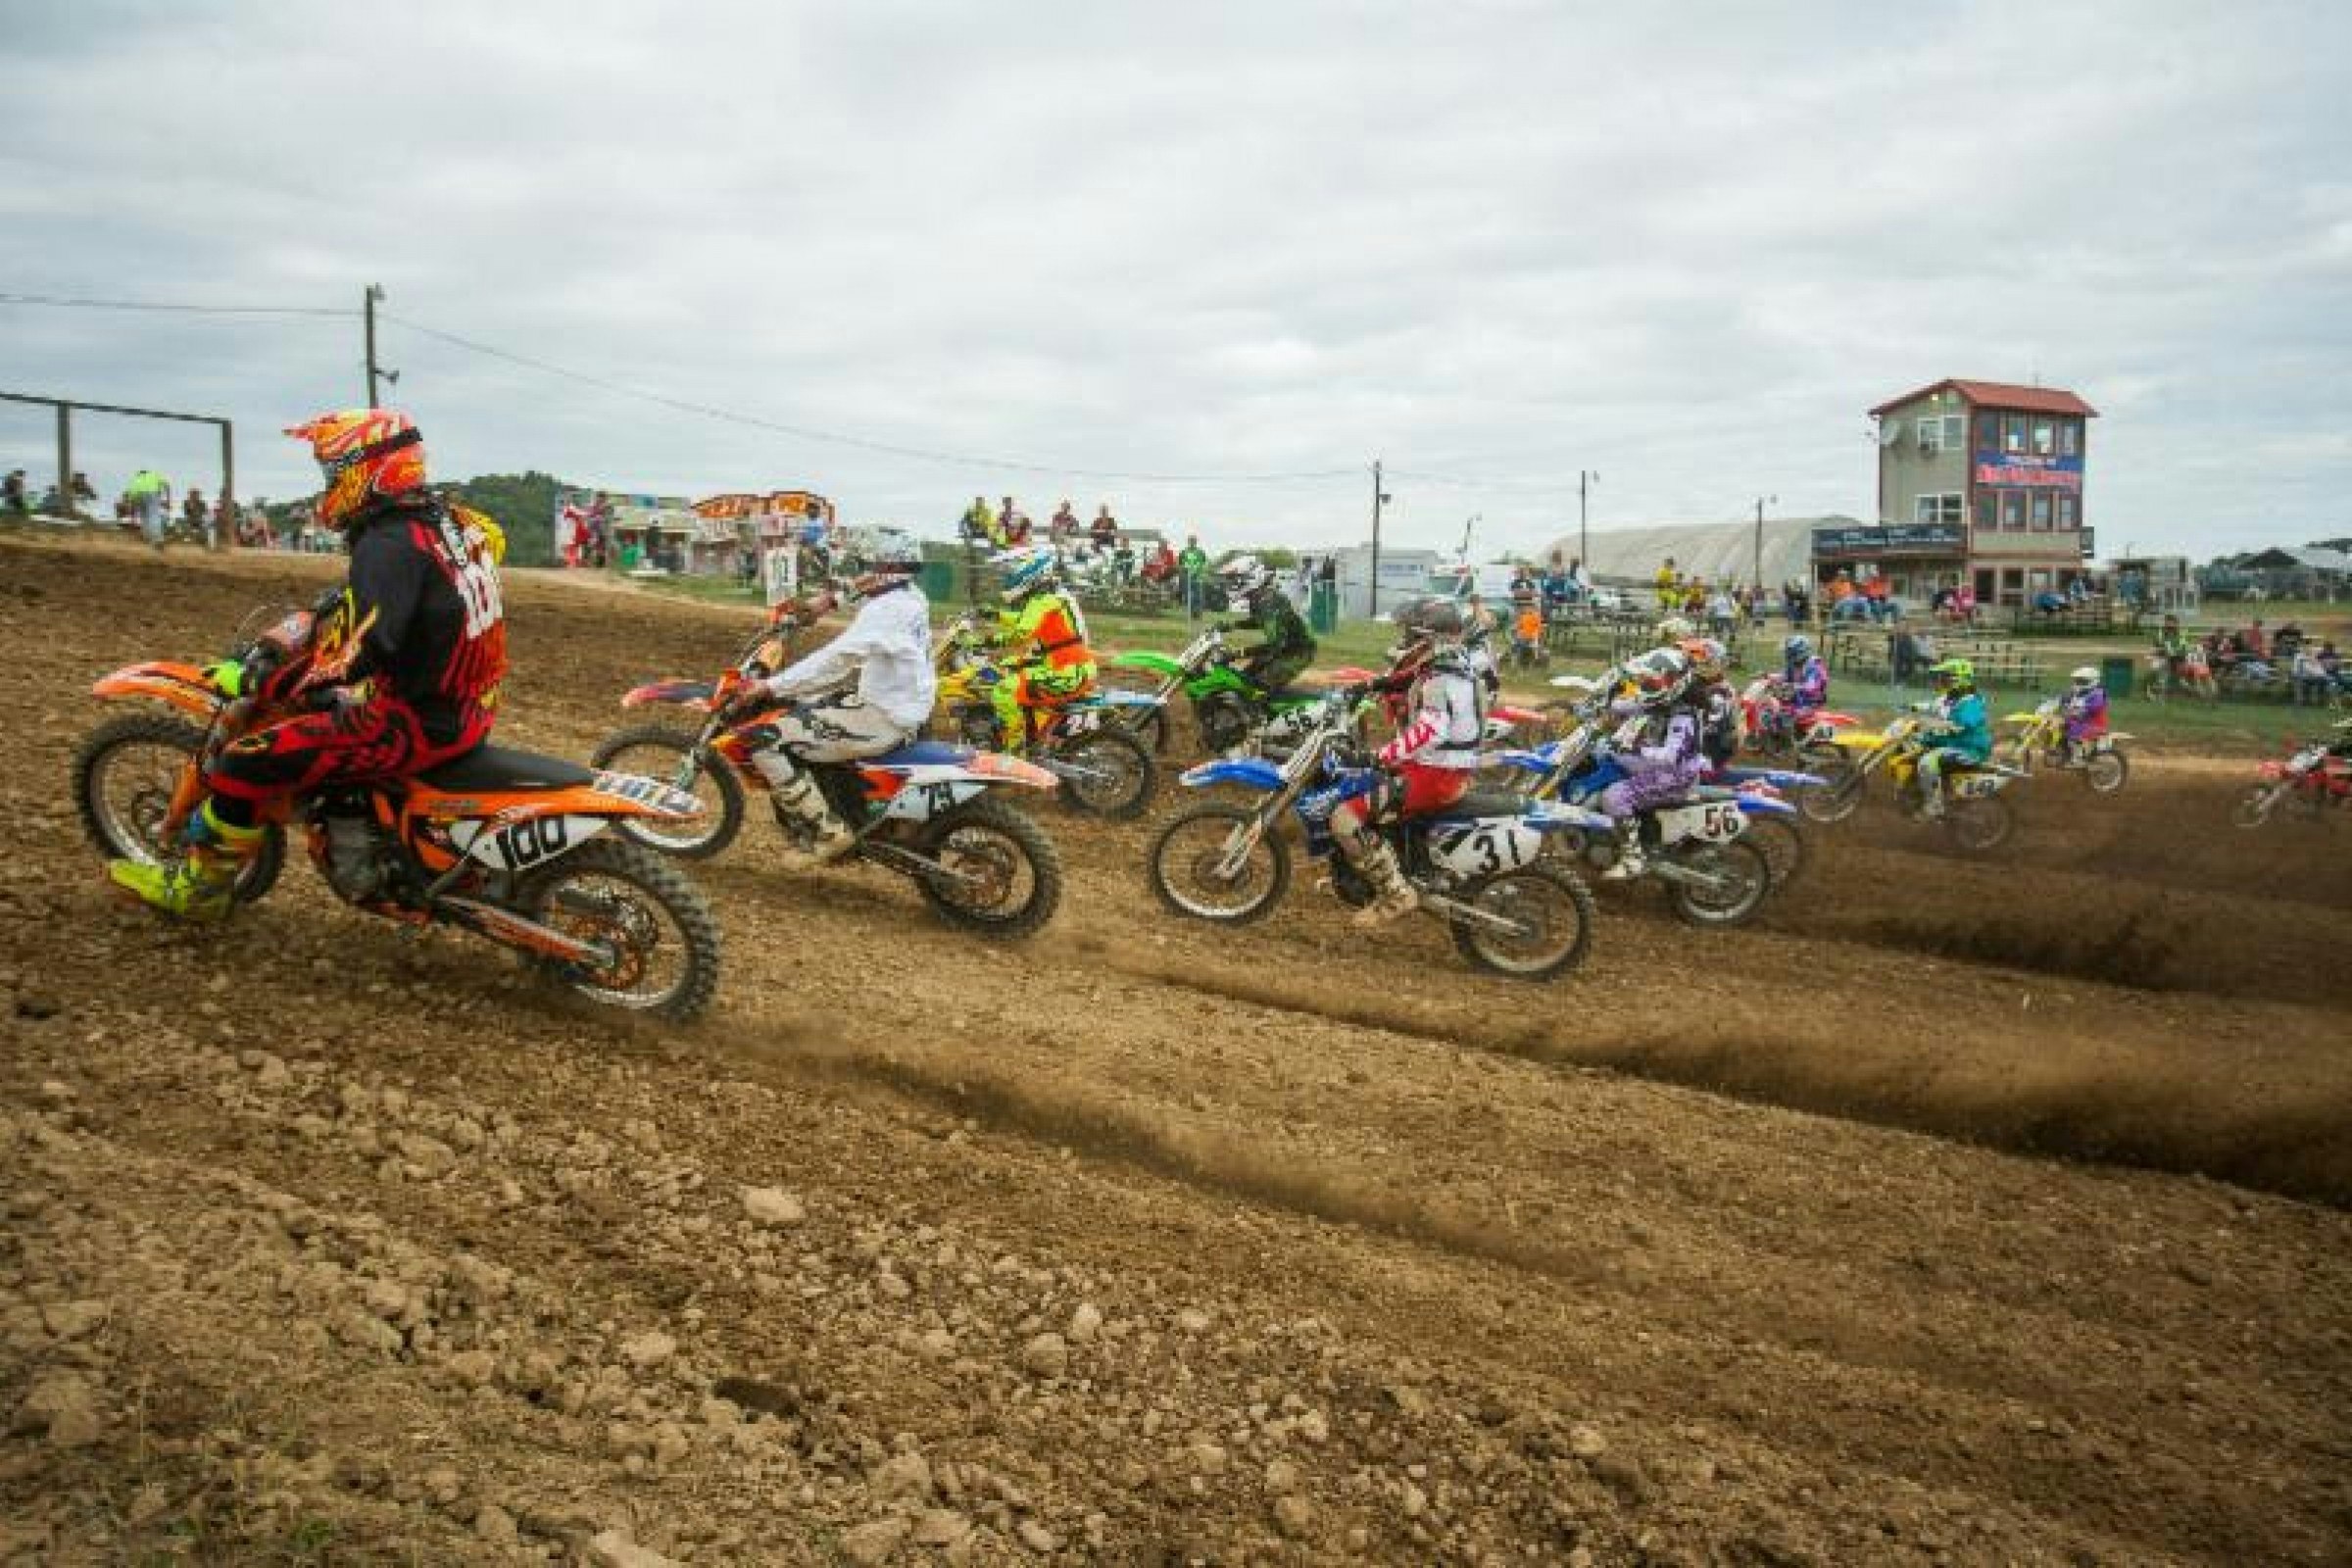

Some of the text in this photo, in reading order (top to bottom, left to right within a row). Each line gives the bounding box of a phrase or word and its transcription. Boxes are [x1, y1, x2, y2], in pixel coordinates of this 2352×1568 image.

[495, 814, 567, 872] 100
[1705, 806, 1739, 839] 56
[1473, 828, 1521, 872] 31
